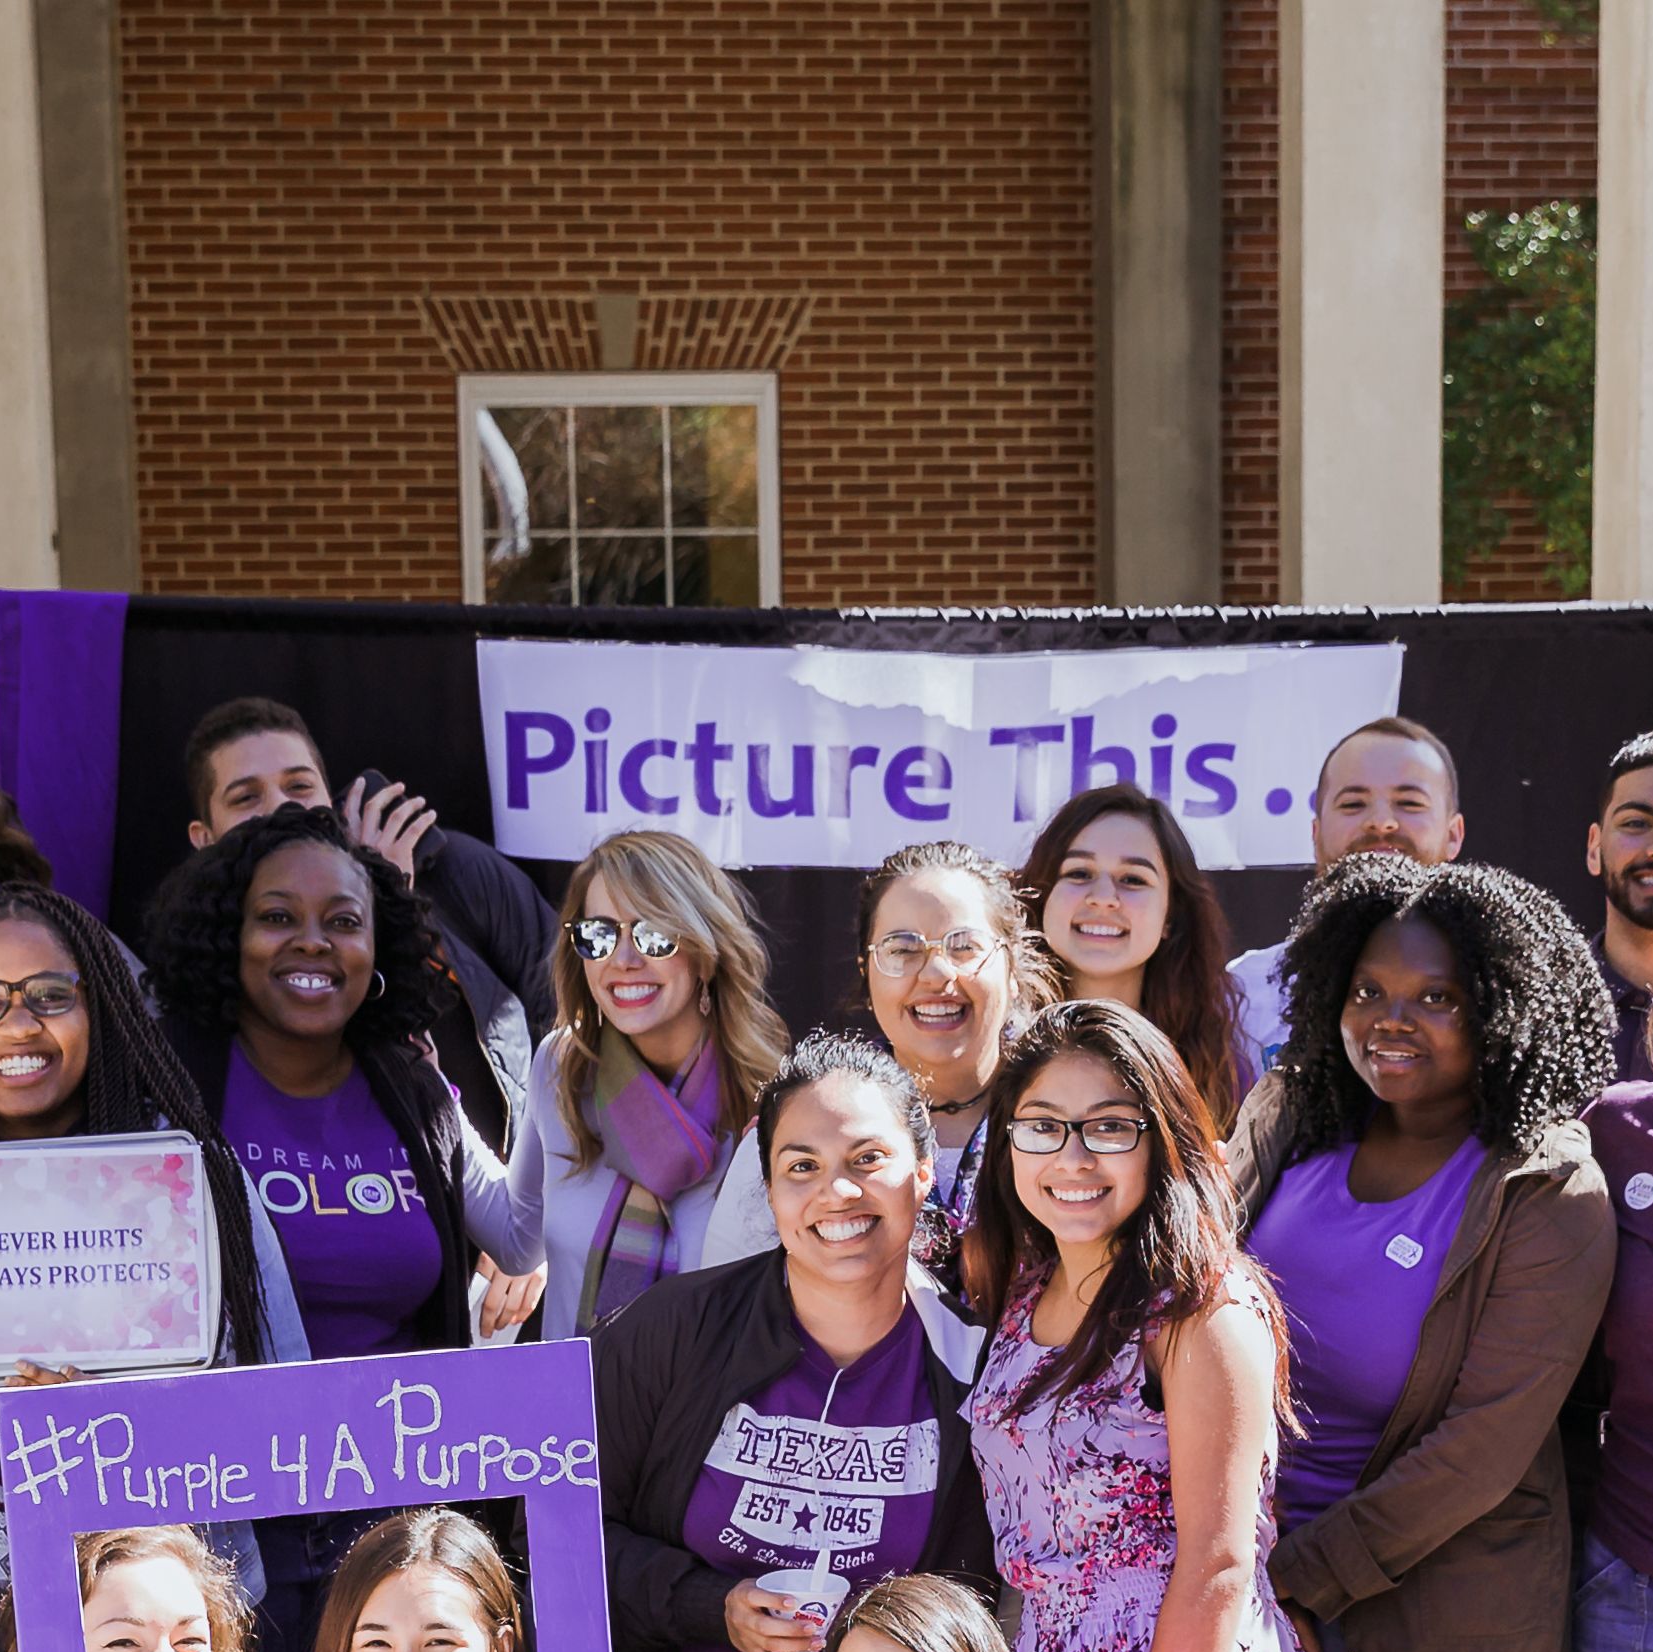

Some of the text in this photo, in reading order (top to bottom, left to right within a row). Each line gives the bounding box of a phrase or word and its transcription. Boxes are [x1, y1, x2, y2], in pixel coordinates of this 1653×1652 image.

[503, 706, 953, 822] Picture
[247, 1143, 363, 1171] DREAM
[259, 1169, 426, 1214] OLOR
[62, 1227, 144, 1250] HURTS
[48, 1261, 172, 1286] PROTECTS
[6, 1377, 598, 1512] #Purple 4 A Purpose
[735, 1416, 908, 1483] TEXAS
[743, 1491, 874, 1535] EST 1845
